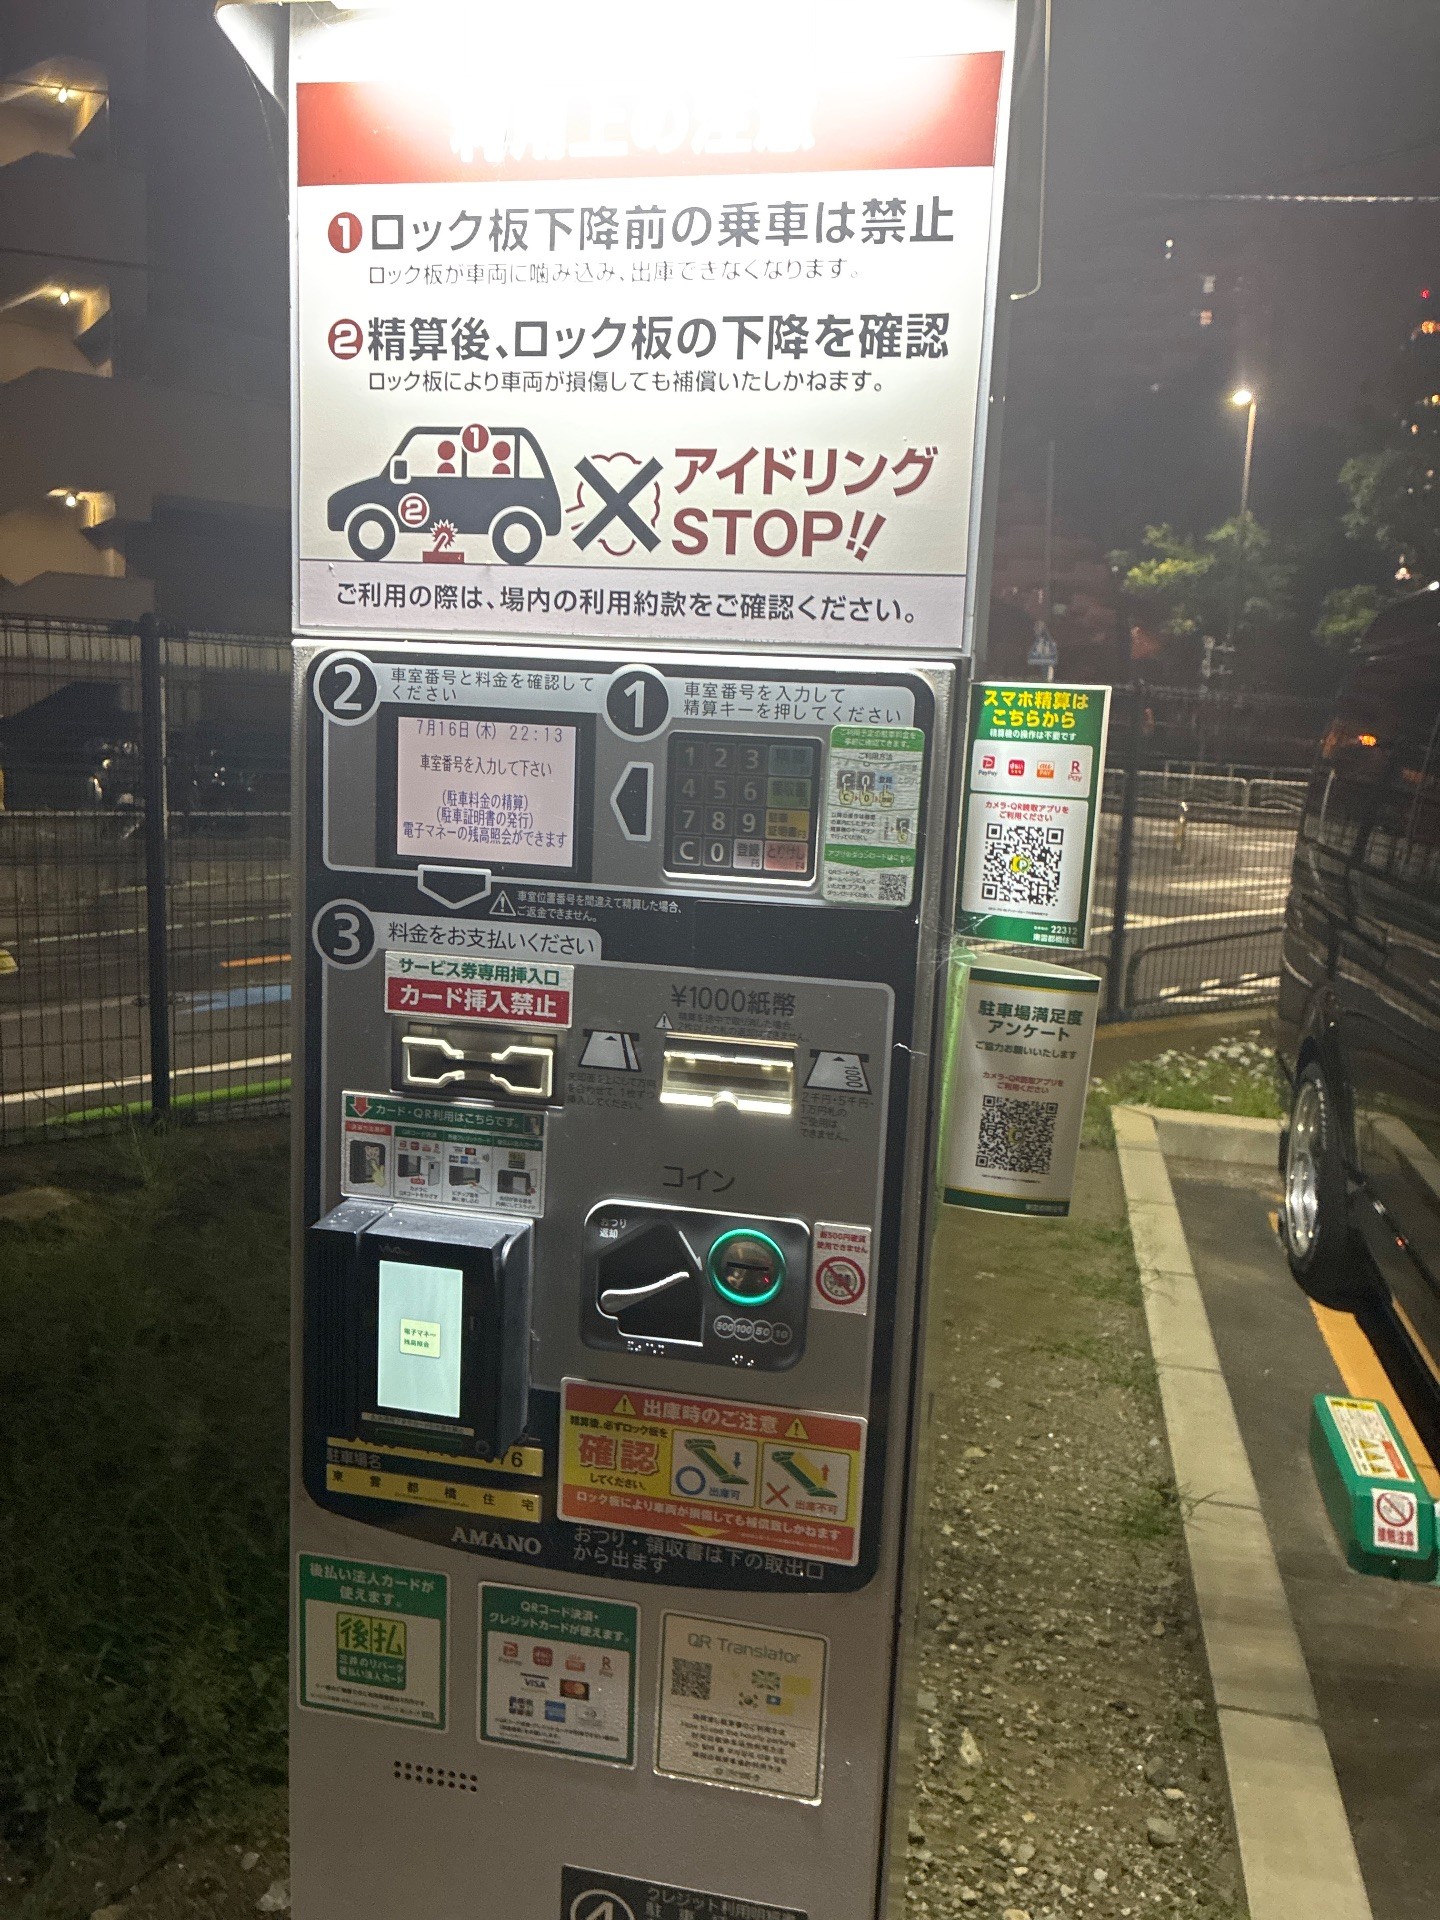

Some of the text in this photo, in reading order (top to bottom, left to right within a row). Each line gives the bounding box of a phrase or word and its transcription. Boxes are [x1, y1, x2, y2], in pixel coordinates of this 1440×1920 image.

[371, 197, 955, 254] ロック板下降前の乗車は禁止
[366, 312, 951, 362] 精算後、ロック板の下降を確認
[368, 368, 885, 395] ロック板により車両が損傷しても補償いたしかねます。
[673, 446, 939, 500] アイドリング
[670, 510, 888, 562] STOP!!
[335, 581, 920, 625] ご利用の際は、場内の利用約款をご確認ください。
[333, 663, 362, 711] 2
[391, 667, 594, 692] 車室番号と料金を確認して
[684, 681, 845, 703] 車室番号を入力して
[391, 685, 457, 702] ください
[623, 680, 645, 728] 1
[984, 689, 1089, 710] スマホ精算は
[683, 700, 901, 723] 精算キーを押してください
[992, 709, 1076, 729] こちらから
[509, 724, 563, 743] 22:13
[420, 753, 552, 776] 車室番号を入力して下さい
[685, 746, 695, 766] 1
[715, 747, 728, 768] 2
[745, 749, 760, 770] 3
[681, 778, 758, 801] 4 5 6
[402, 821, 567, 848] 電子マネーの残高照会ができます
[683, 810, 756, 833] 7 8 9
[680, 841, 694, 861] C
[517, 890, 684, 915] 車室位置番号を間違えて精算した場合、
[517, 905, 598, 923] ご返金できません。
[333, 914, 361, 957] 3
[388, 922, 594, 955] 料金をお支払いください
[1050, 925, 1078, 936] 22312
[399, 958, 560, 986] サービス券専用挿入口
[400, 984, 557, 1018] カード挿入禁止
[978, 999, 1084, 1027] 駐車場満足度
[988, 1018, 1070, 1042] アンケート
[662, 1165, 735, 1193] コイン
[404, 1327, 437, 1338] 電子マネー
[716, 1321, 733, 1333] 500
[736, 1323, 752, 1336] 100
[755, 1325, 771, 1337] 50
[643, 1399, 778, 1434] 出庫時のご注意
[578, 1432, 660, 1475] 確認
[452, 1526, 542, 1555] AMANO
[573, 1545, 668, 1574] から出ます
[340, 1616, 403, 1656] 後払
[687, 1632, 802, 1665] QR Translator
[525, 1677, 546, 1690] VISA
